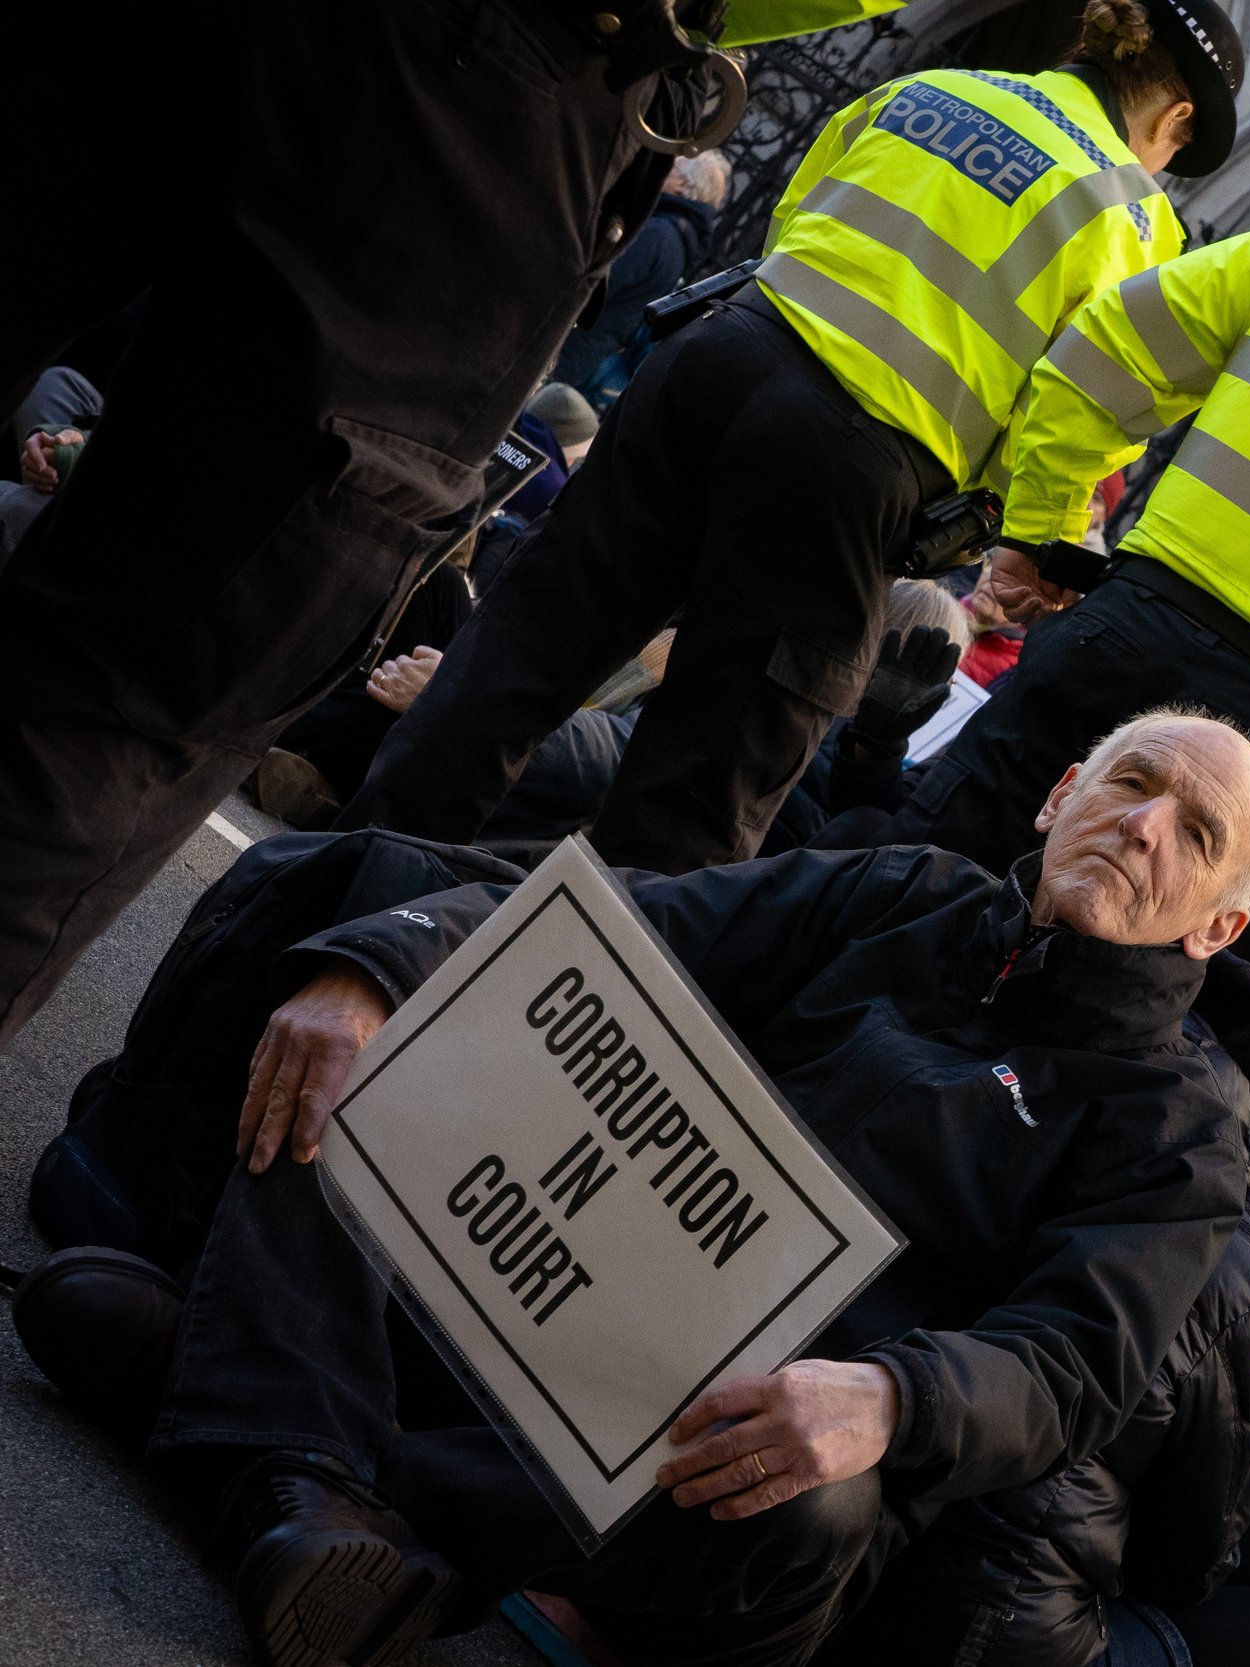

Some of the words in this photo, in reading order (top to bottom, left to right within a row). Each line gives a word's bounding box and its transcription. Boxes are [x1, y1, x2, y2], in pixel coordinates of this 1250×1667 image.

[878, 97, 1034, 200] POLICE
[904, 84, 1051, 172] METROPOLITAN
[494, 440, 532, 470] SONERS
[525, 967, 769, 1270] CORRUPTION
[538, 1131, 618, 1221] IN
[447, 1154, 594, 1327] COURT
